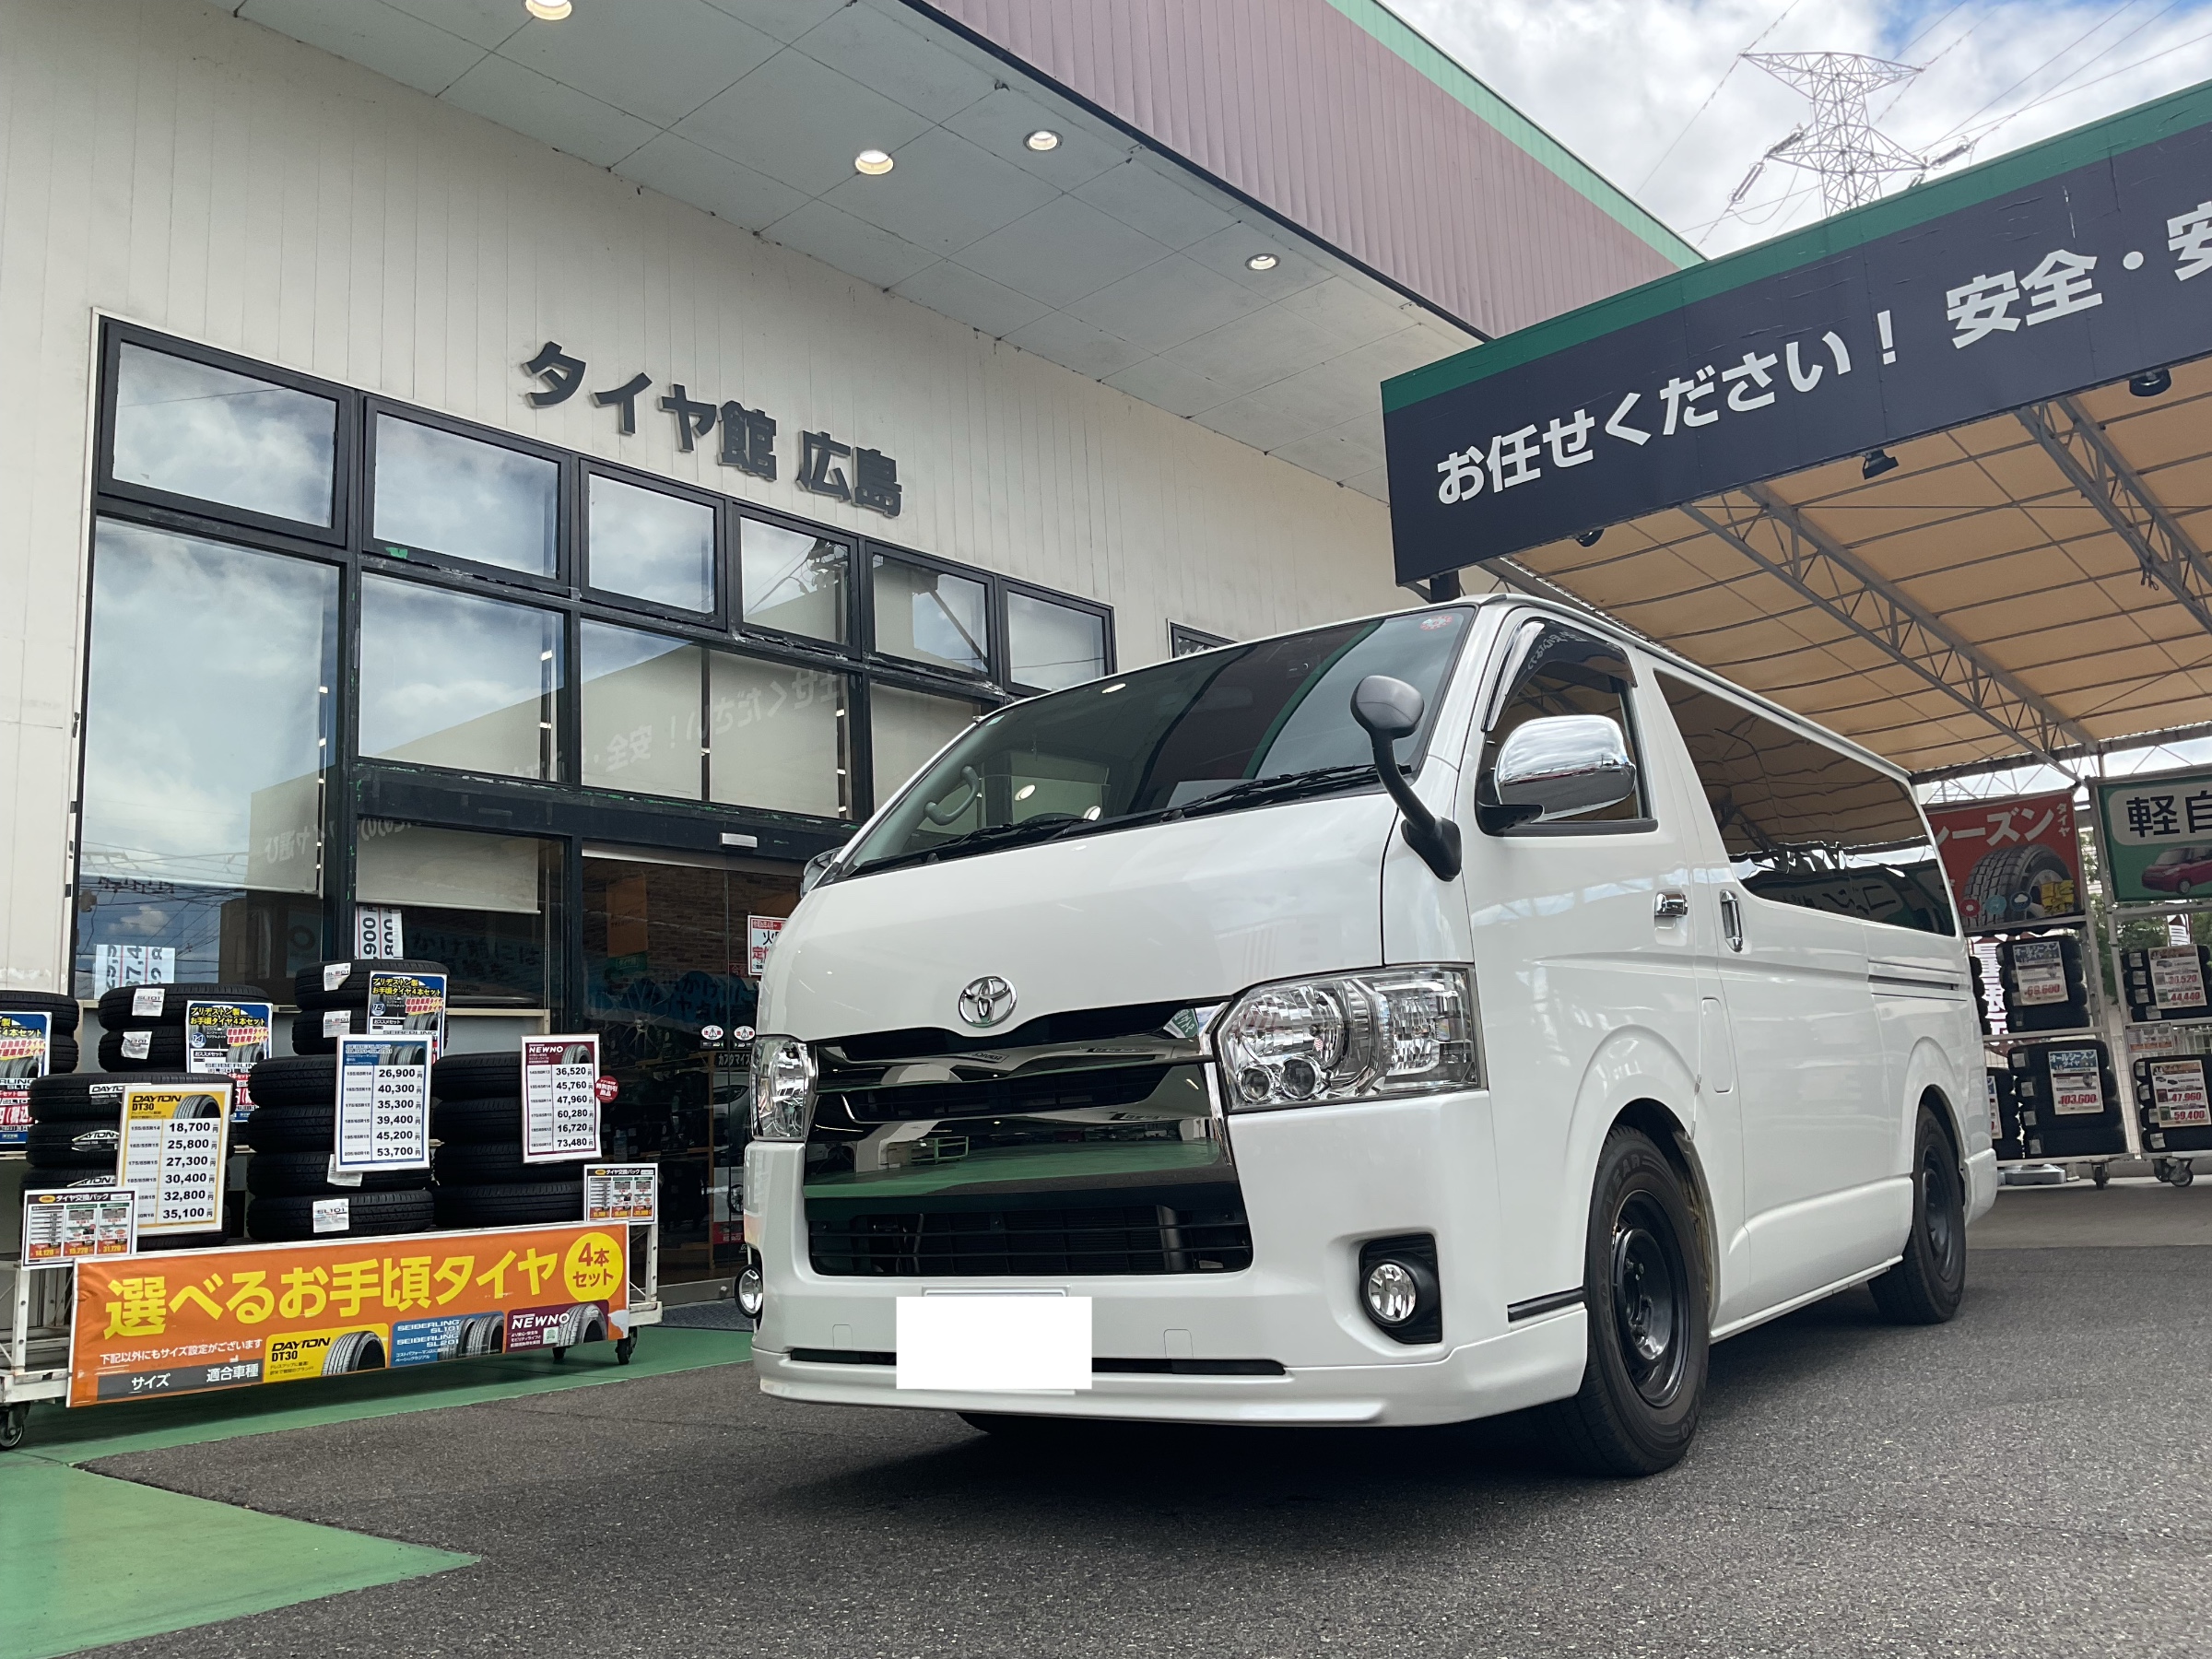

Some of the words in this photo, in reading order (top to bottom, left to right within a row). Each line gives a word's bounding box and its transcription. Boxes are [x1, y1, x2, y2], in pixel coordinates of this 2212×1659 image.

[1436, 310, 1898, 506] お任せください！
[522, 341, 777, 481] タイヤ館
[796, 429, 902, 519] 広島
[763, 930, 779, 945] 火
[529, 1045, 563, 1053] NEWNO
[379, 1069, 415, 1079] 26,900
[556, 1067, 586, 1077] 36,520
[378, 1085, 415, 1094] 40,300
[557, 1081, 587, 1091] 45,760
[378, 1100, 414, 1110] 35,300
[557, 1095, 587, 1105] 47,960
[558, 1110, 588, 1119] 60,280
[377, 1116, 413, 1126] 39,400
[170, 1123, 210, 1134] 18,700
[558, 1124, 587, 1134] 16,720
[376, 1131, 413, 1142] 45,200
[168, 1139, 209, 1150] 25,800
[558, 1138, 587, 1147] 73,480
[377, 1147, 413, 1158] 53,700
[166, 1156, 207, 1168] 27,300
[165, 1173, 206, 1185] 30,400
[164, 1190, 206, 1202] 32,800
[163, 1208, 204, 1220] 35,100
[578, 1242, 610, 1267] 4本
[572, 1268, 614, 1288] セット
[103, 1248, 558, 1339] 選べるお手頃タイヤ
[397, 1319, 460, 1332] SEIBERLING
[512, 1312, 570, 1330] NEWNO
[430, 1325, 459, 1334] SL101
[272, 1337, 331, 1352] DAYTON
[397, 1333, 459, 1346] SEIBERLING
[427, 1339, 458, 1347] SL201
[100, 1338, 263, 1365] 下記以外にもサイズ設定がございます
[272, 1351, 298, 1362] DT30
[206, 1364, 259, 1383] 適合車種
[131, 1373, 171, 1392] サイズ
